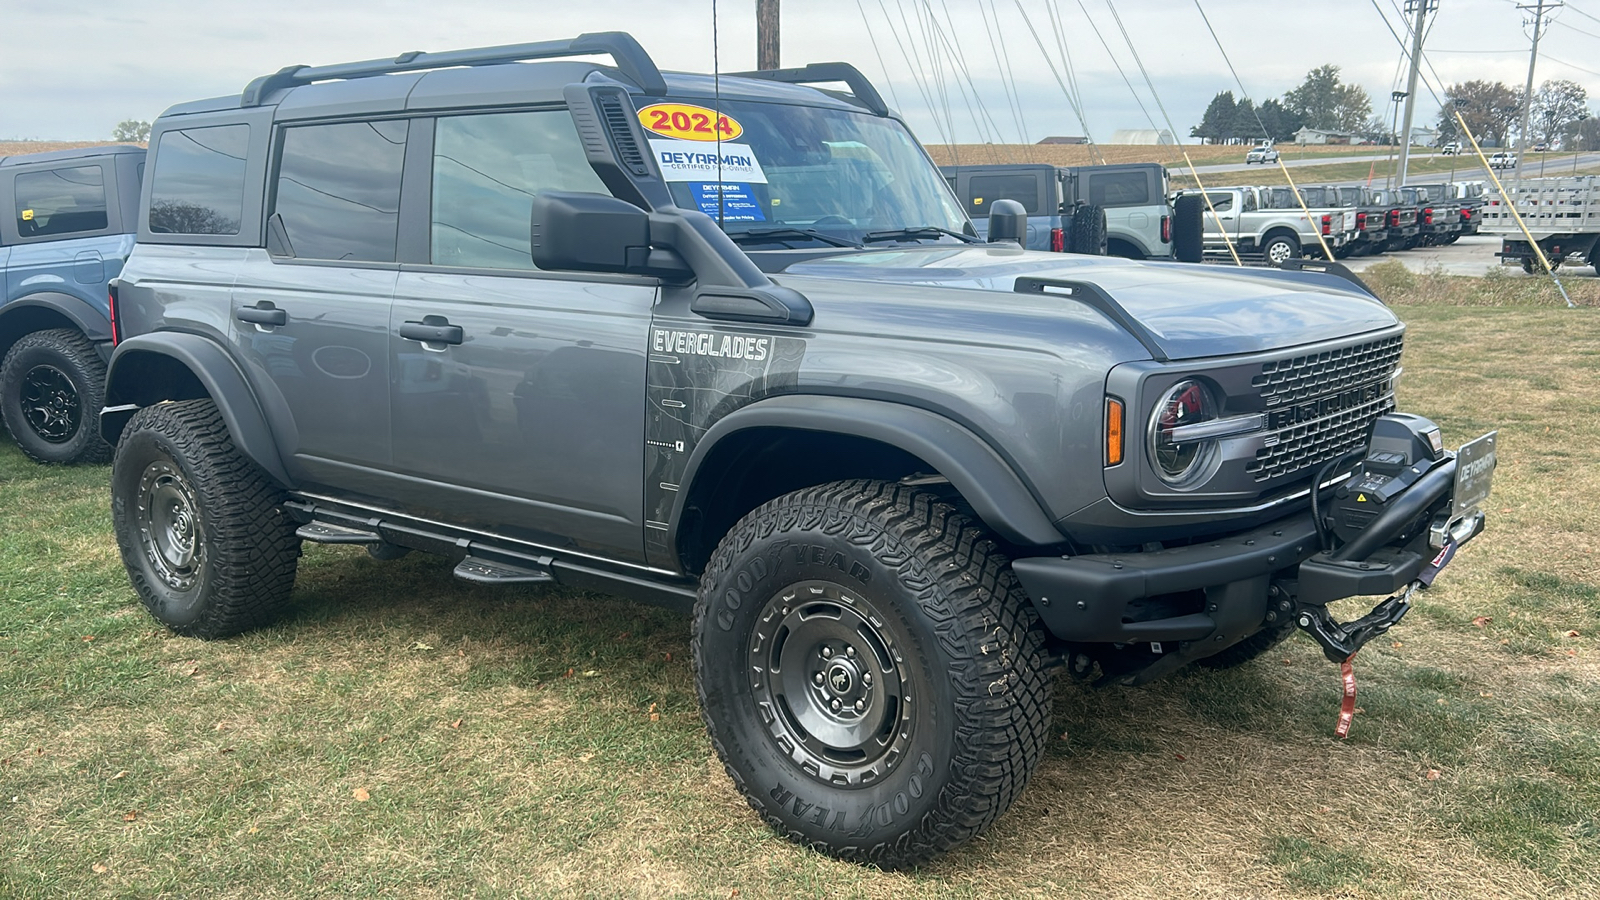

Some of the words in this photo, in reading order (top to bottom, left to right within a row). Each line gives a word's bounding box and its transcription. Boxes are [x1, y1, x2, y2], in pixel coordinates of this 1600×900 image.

[649, 110, 734, 136] 2024
[660, 151, 752, 167] DEYARMAN
[670, 163, 711, 171] CERTIFIED
[712, 164, 754, 173] PE-OWNED
[653, 329, 769, 361] EVERGLADES
